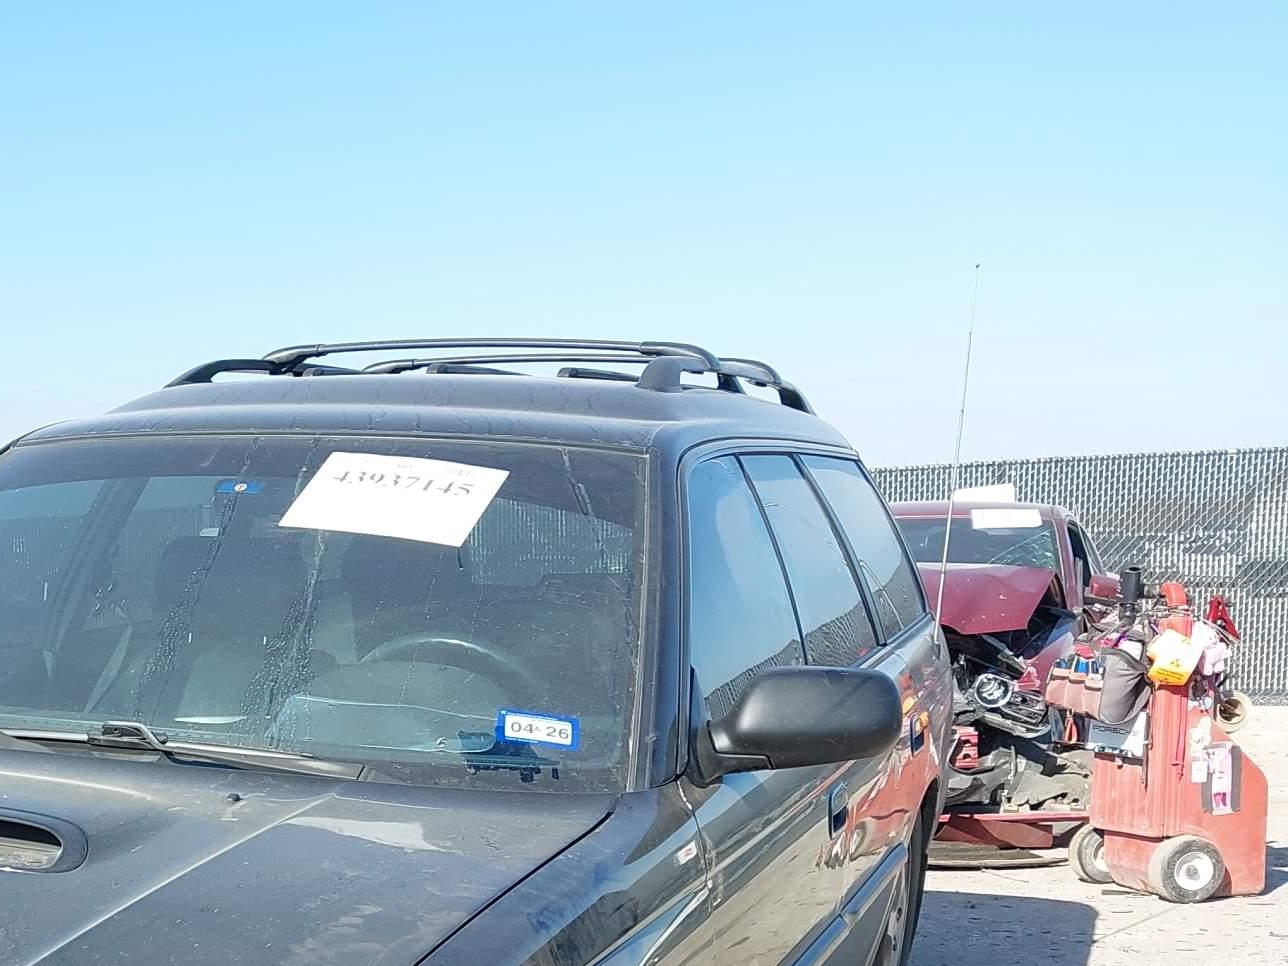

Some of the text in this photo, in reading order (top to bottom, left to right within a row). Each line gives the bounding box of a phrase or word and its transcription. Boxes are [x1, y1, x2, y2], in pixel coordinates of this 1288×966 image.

[333, 470, 475, 496] 43937145
[510, 721, 570, 740] 04 26
